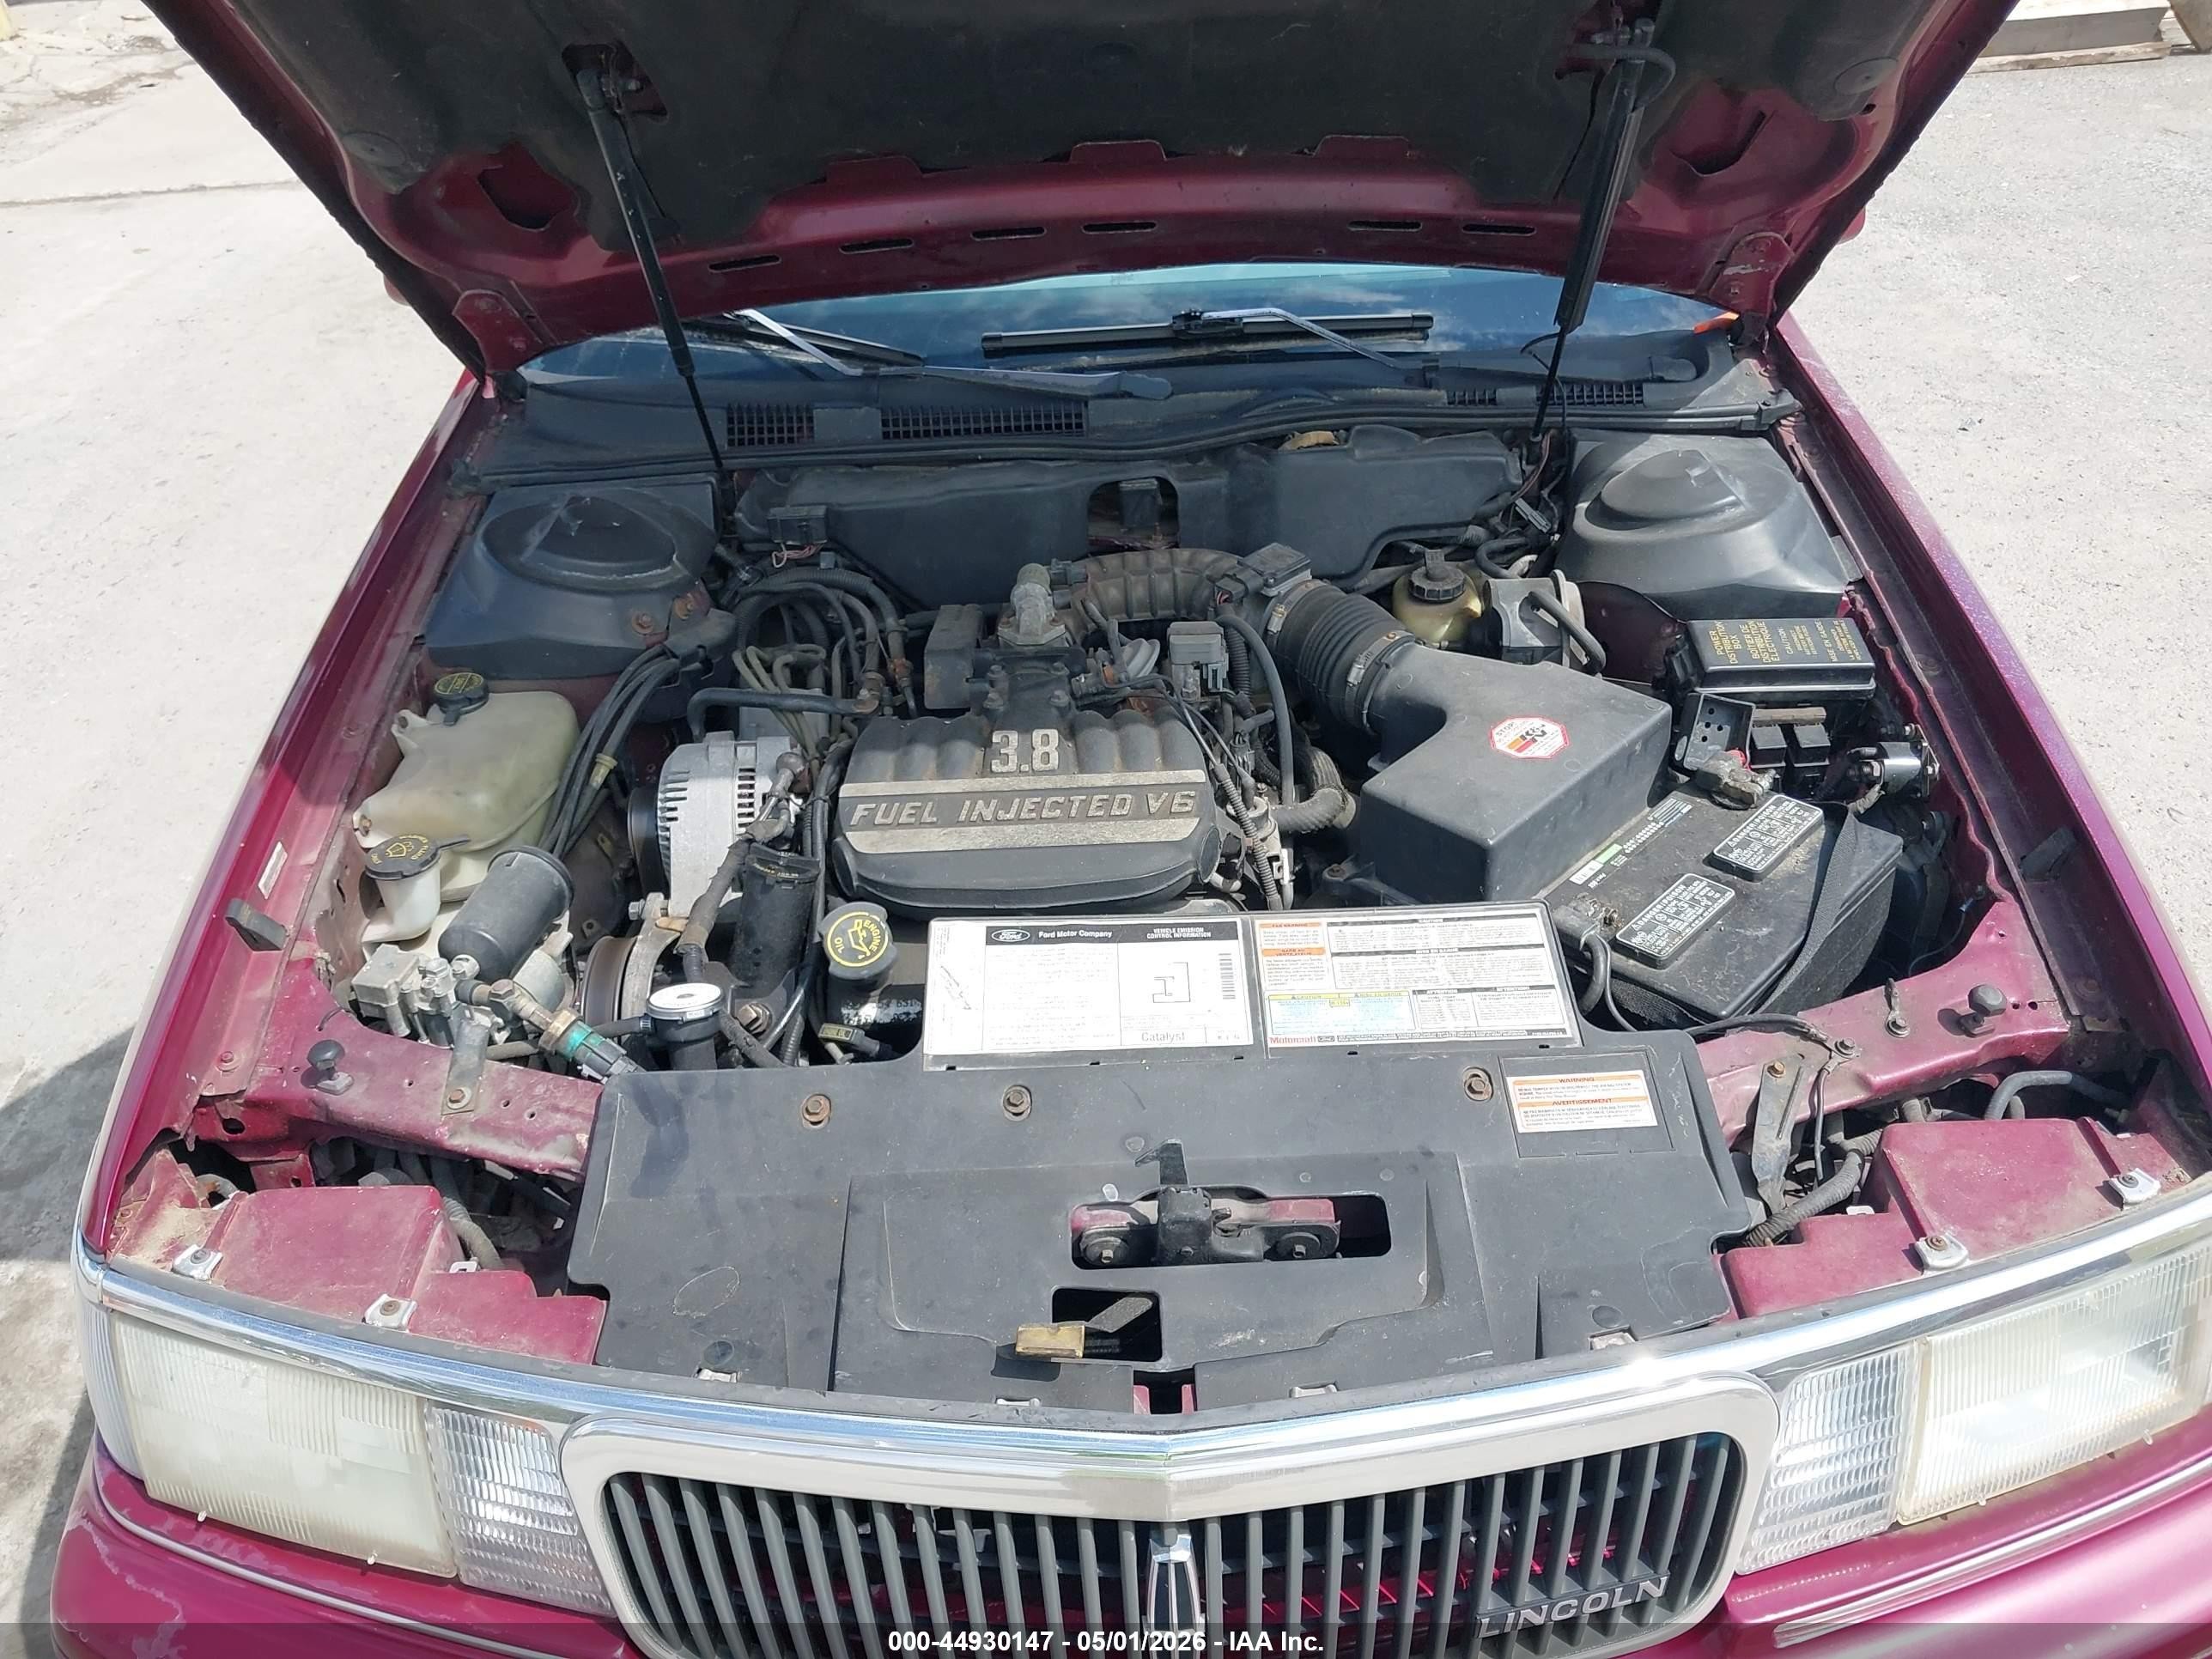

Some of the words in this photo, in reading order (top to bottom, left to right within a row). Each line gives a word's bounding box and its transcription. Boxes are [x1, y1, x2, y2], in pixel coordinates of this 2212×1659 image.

[1739, 624, 1750, 633] DE
[1709, 630, 1725, 655] POWER
[1715, 621, 1738, 664] DISTRIBUTION
[1730, 635, 1741, 649] BOX
[1748, 621, 1771, 663] DISTRIBUTION
[1827, 647, 1838, 662] MISE
[991, 729, 1059, 773] 3.8
[849, 801, 938, 826] FUEL
[957, 793, 1133, 822] INJECTED
[1146, 790, 1196, 815] V6
[1734, 805, 1777, 842] DANGER/POISON
[1638, 884, 1686, 927] DANGER/POISON
[834, 937, 845, 953] OIL
[863, 920, 881, 952] ENGINE
[999, 930, 1022, 939] Ford
[1079, 929, 1113, 939] Company
[1141, 1031, 1185, 1043] Catalyst
[1269, 1036, 1316, 1045] Motorcraft
[1478, 1576, 1668, 1638] LINCOLN
